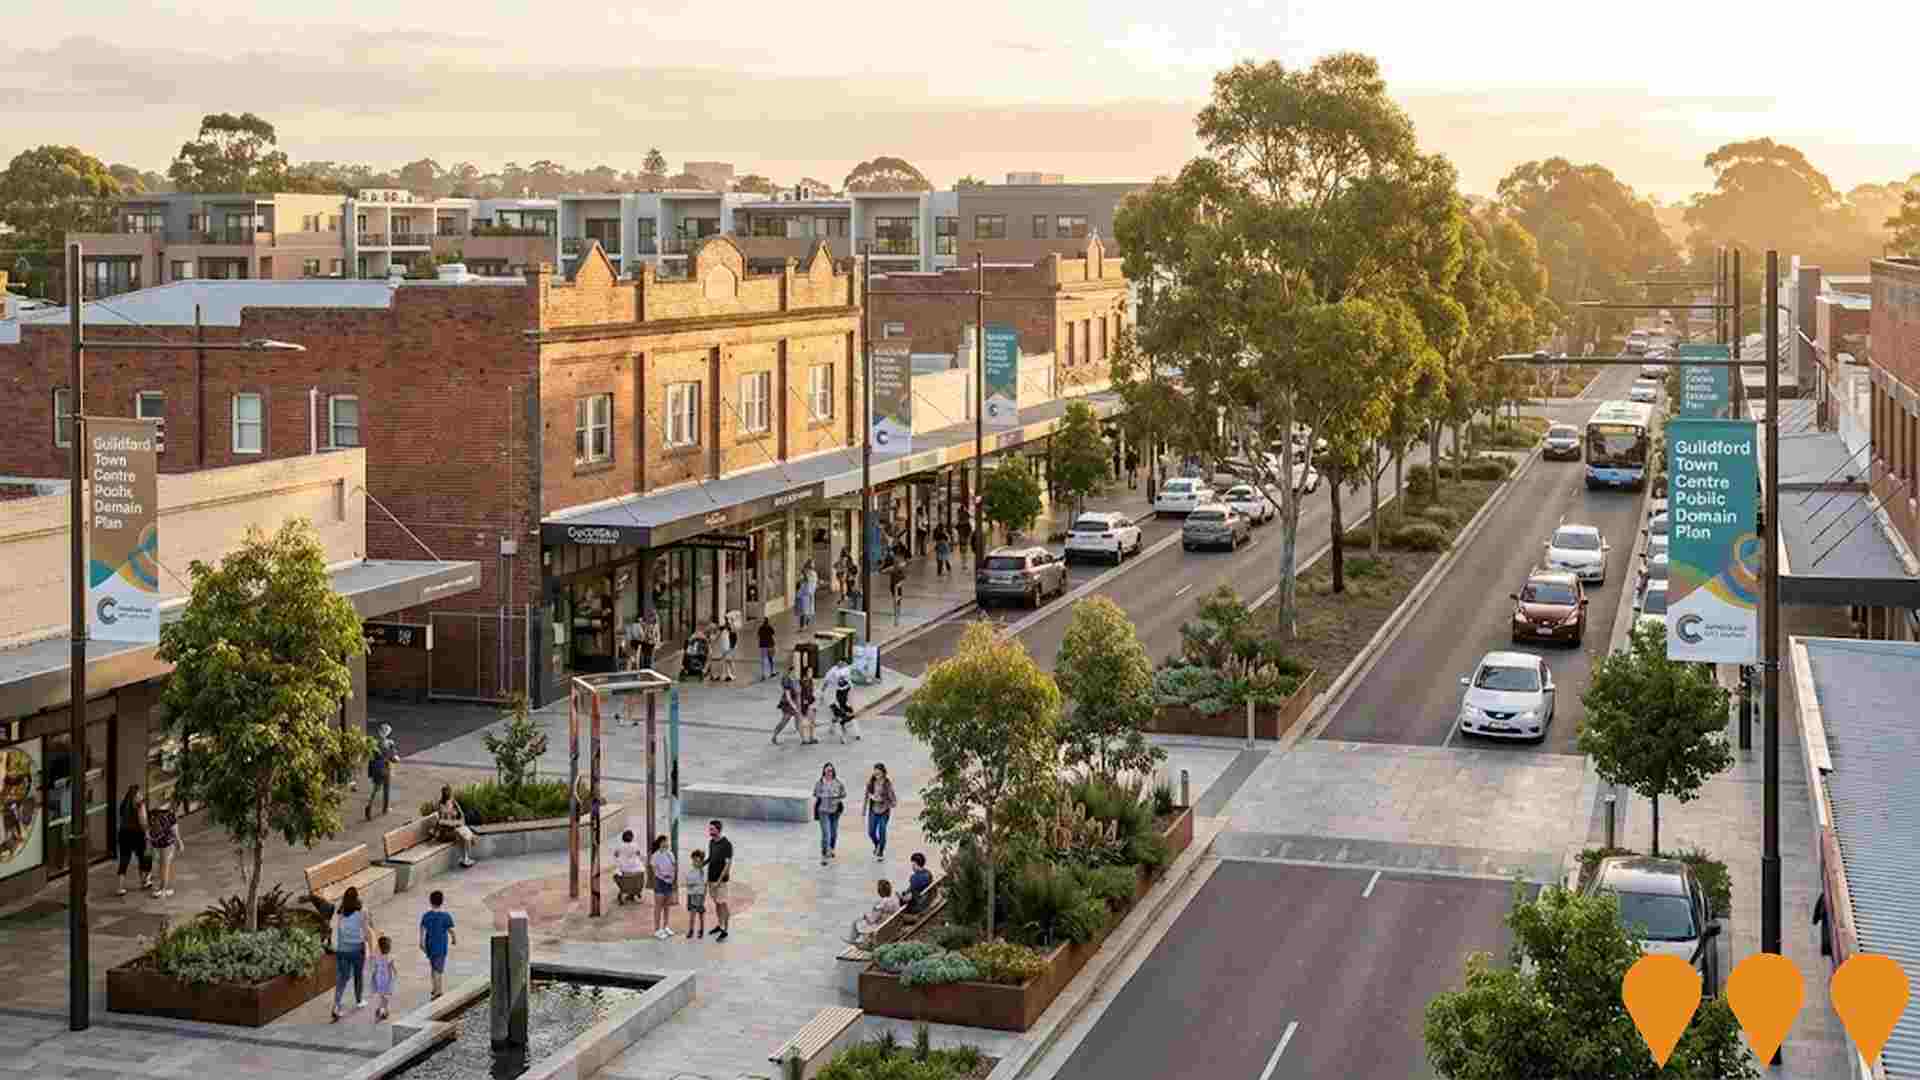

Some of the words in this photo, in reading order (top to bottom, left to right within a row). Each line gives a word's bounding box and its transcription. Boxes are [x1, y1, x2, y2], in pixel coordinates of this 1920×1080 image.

[1675, 440, 1751, 455] Guildford
[94, 453, 127, 466] Town
[1675, 457, 1718, 471] Town
[1675, 474, 1730, 489] Centre
[1675, 508, 1737, 523] Domain
